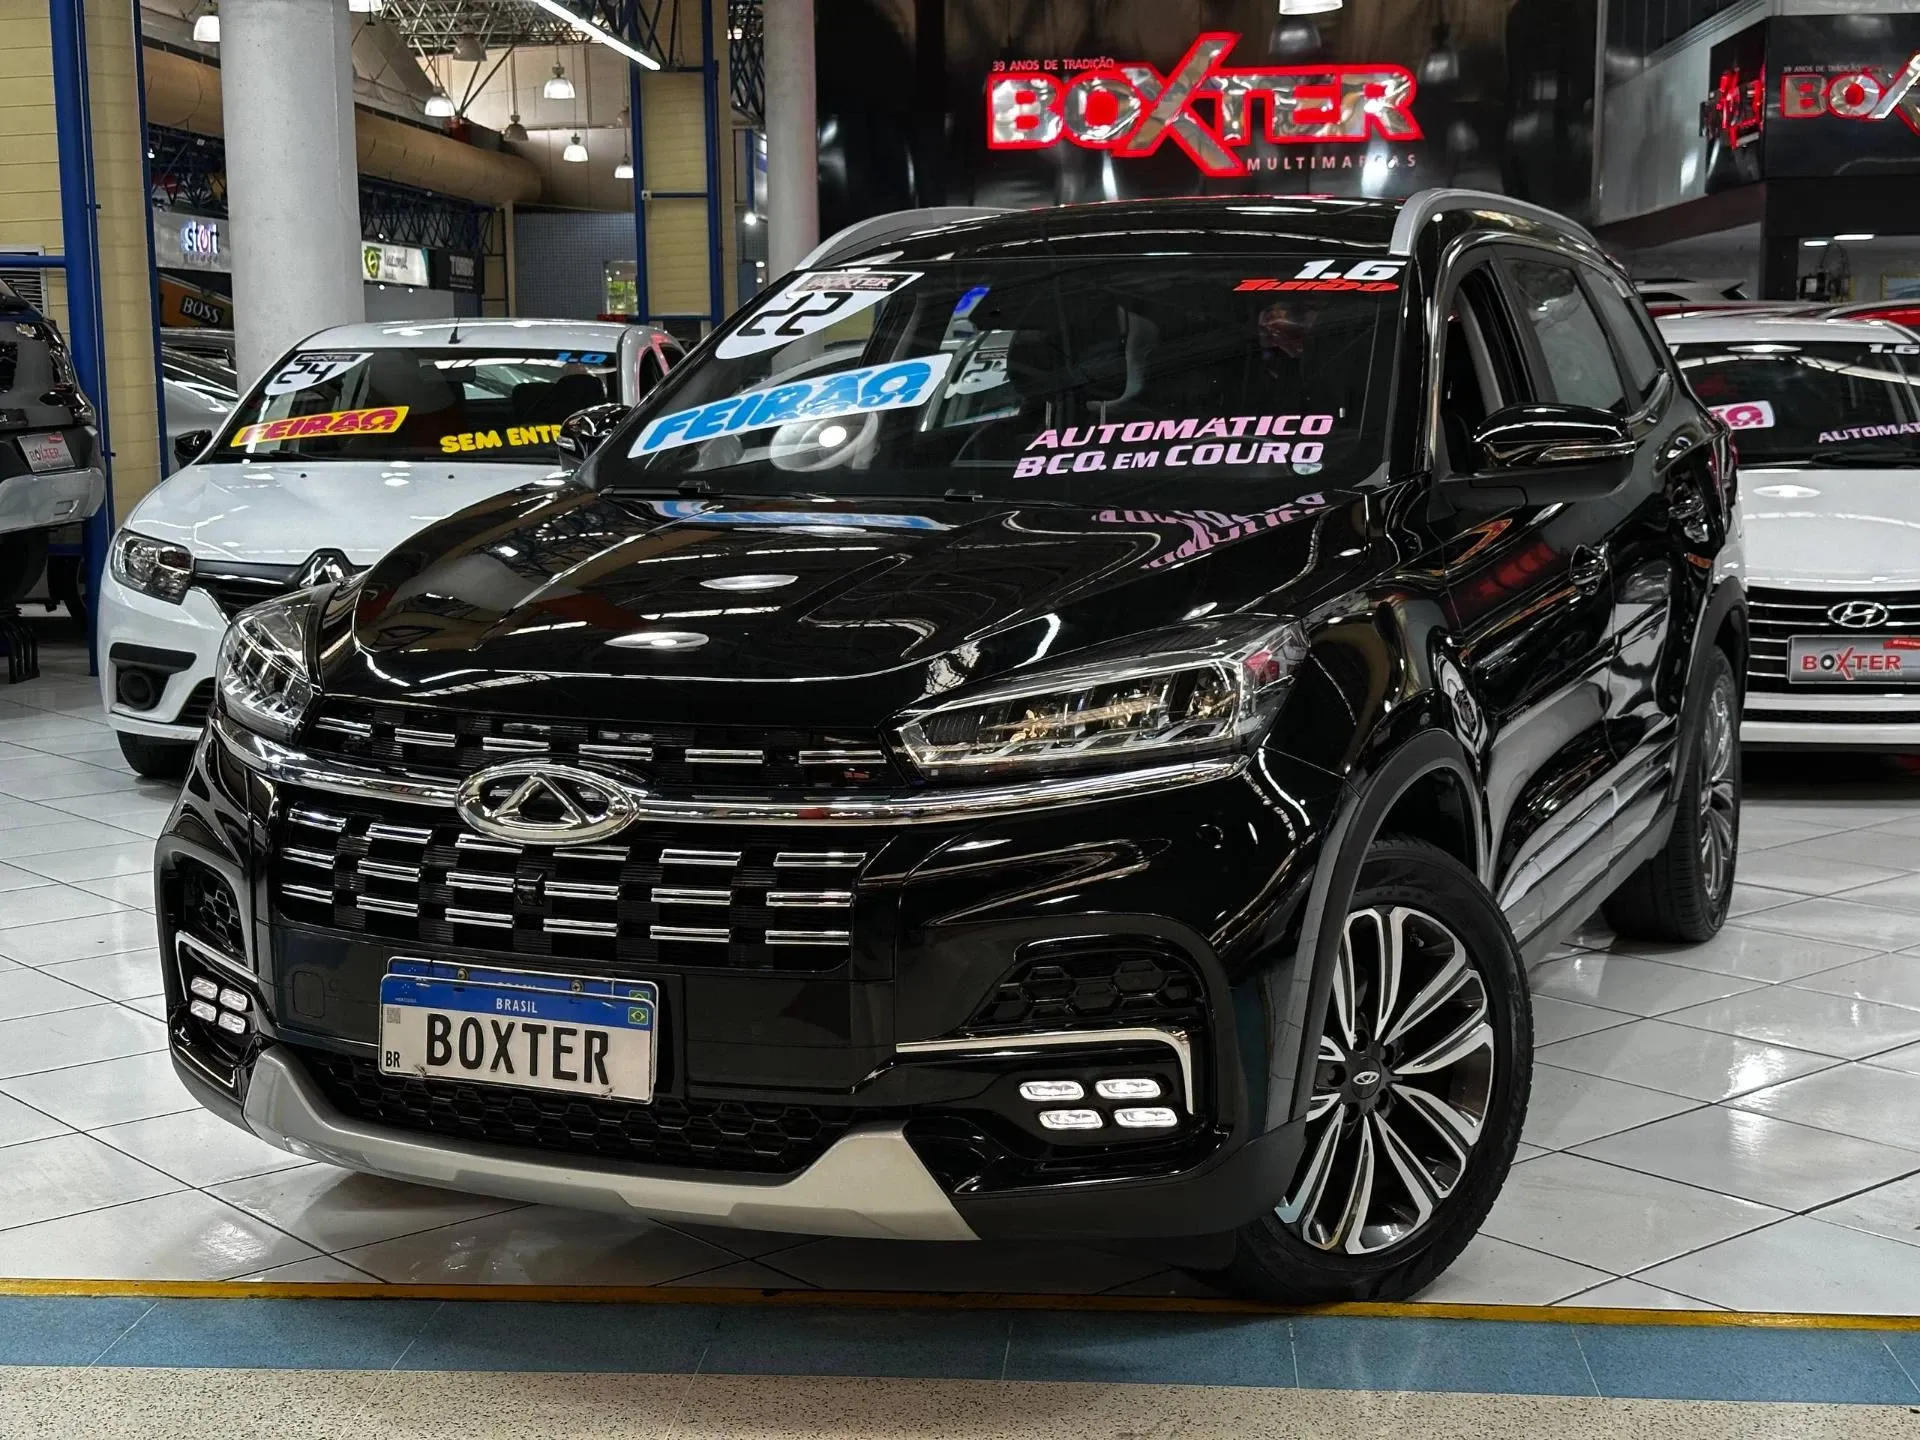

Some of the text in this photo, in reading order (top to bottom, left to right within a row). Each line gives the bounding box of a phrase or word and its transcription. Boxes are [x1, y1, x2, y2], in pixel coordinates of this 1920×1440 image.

[992, 56, 1114, 72] 39 ANOS DE TRADIÇÃO
[988, 32, 1425, 177] BOXTER
[1294, 259, 1408, 281] 1.6
[182, 297, 220, 323] BOSS
[736, 291, 854, 337] 22
[556, 351, 609, 365] 1.0
[1869, 344, 1920, 355] 1.6
[275, 362, 337, 385] 24
[440, 429, 503, 453] SEM
[1012, 442, 1325, 479] BCO. EM COURO
[1801, 646, 1903, 681] BOXTER
[495, 997, 539, 1014] BRASIL
[385, 1050, 401, 1068] BR
[426, 1012, 610, 1086] BOXTER
